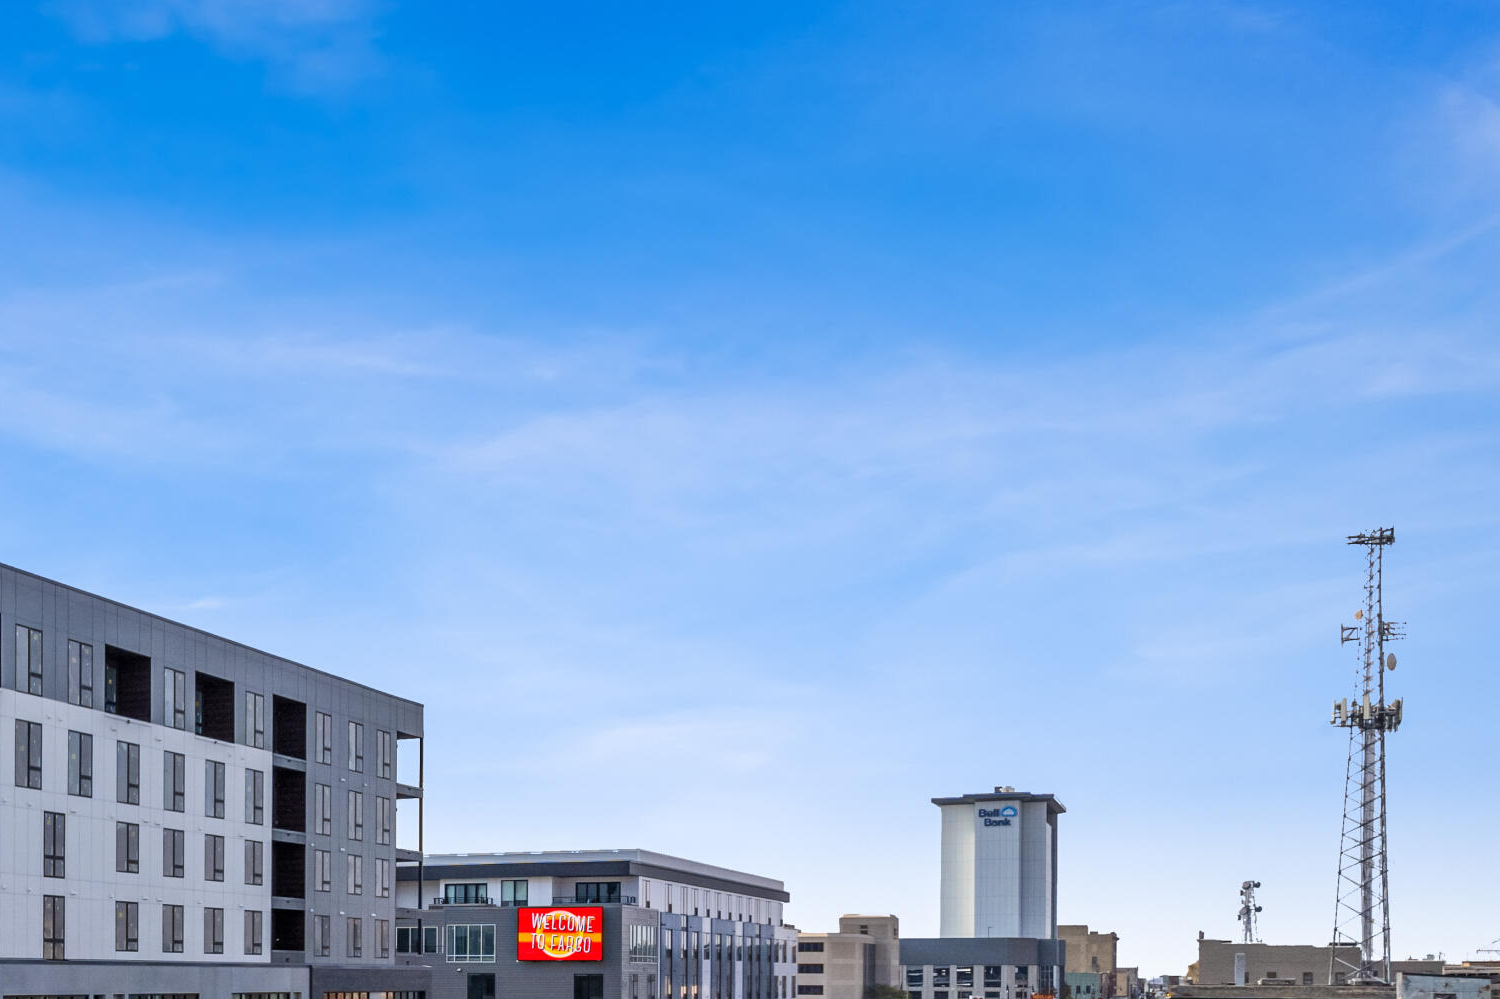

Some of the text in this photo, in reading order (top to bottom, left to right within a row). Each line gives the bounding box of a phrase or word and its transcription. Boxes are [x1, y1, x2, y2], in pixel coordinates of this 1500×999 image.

[979, 809, 1000, 817] Bell
[984, 818, 1011, 826] Bank
[532, 913, 595, 932] WELCOME
[532, 933, 591, 953] TO FARGO
